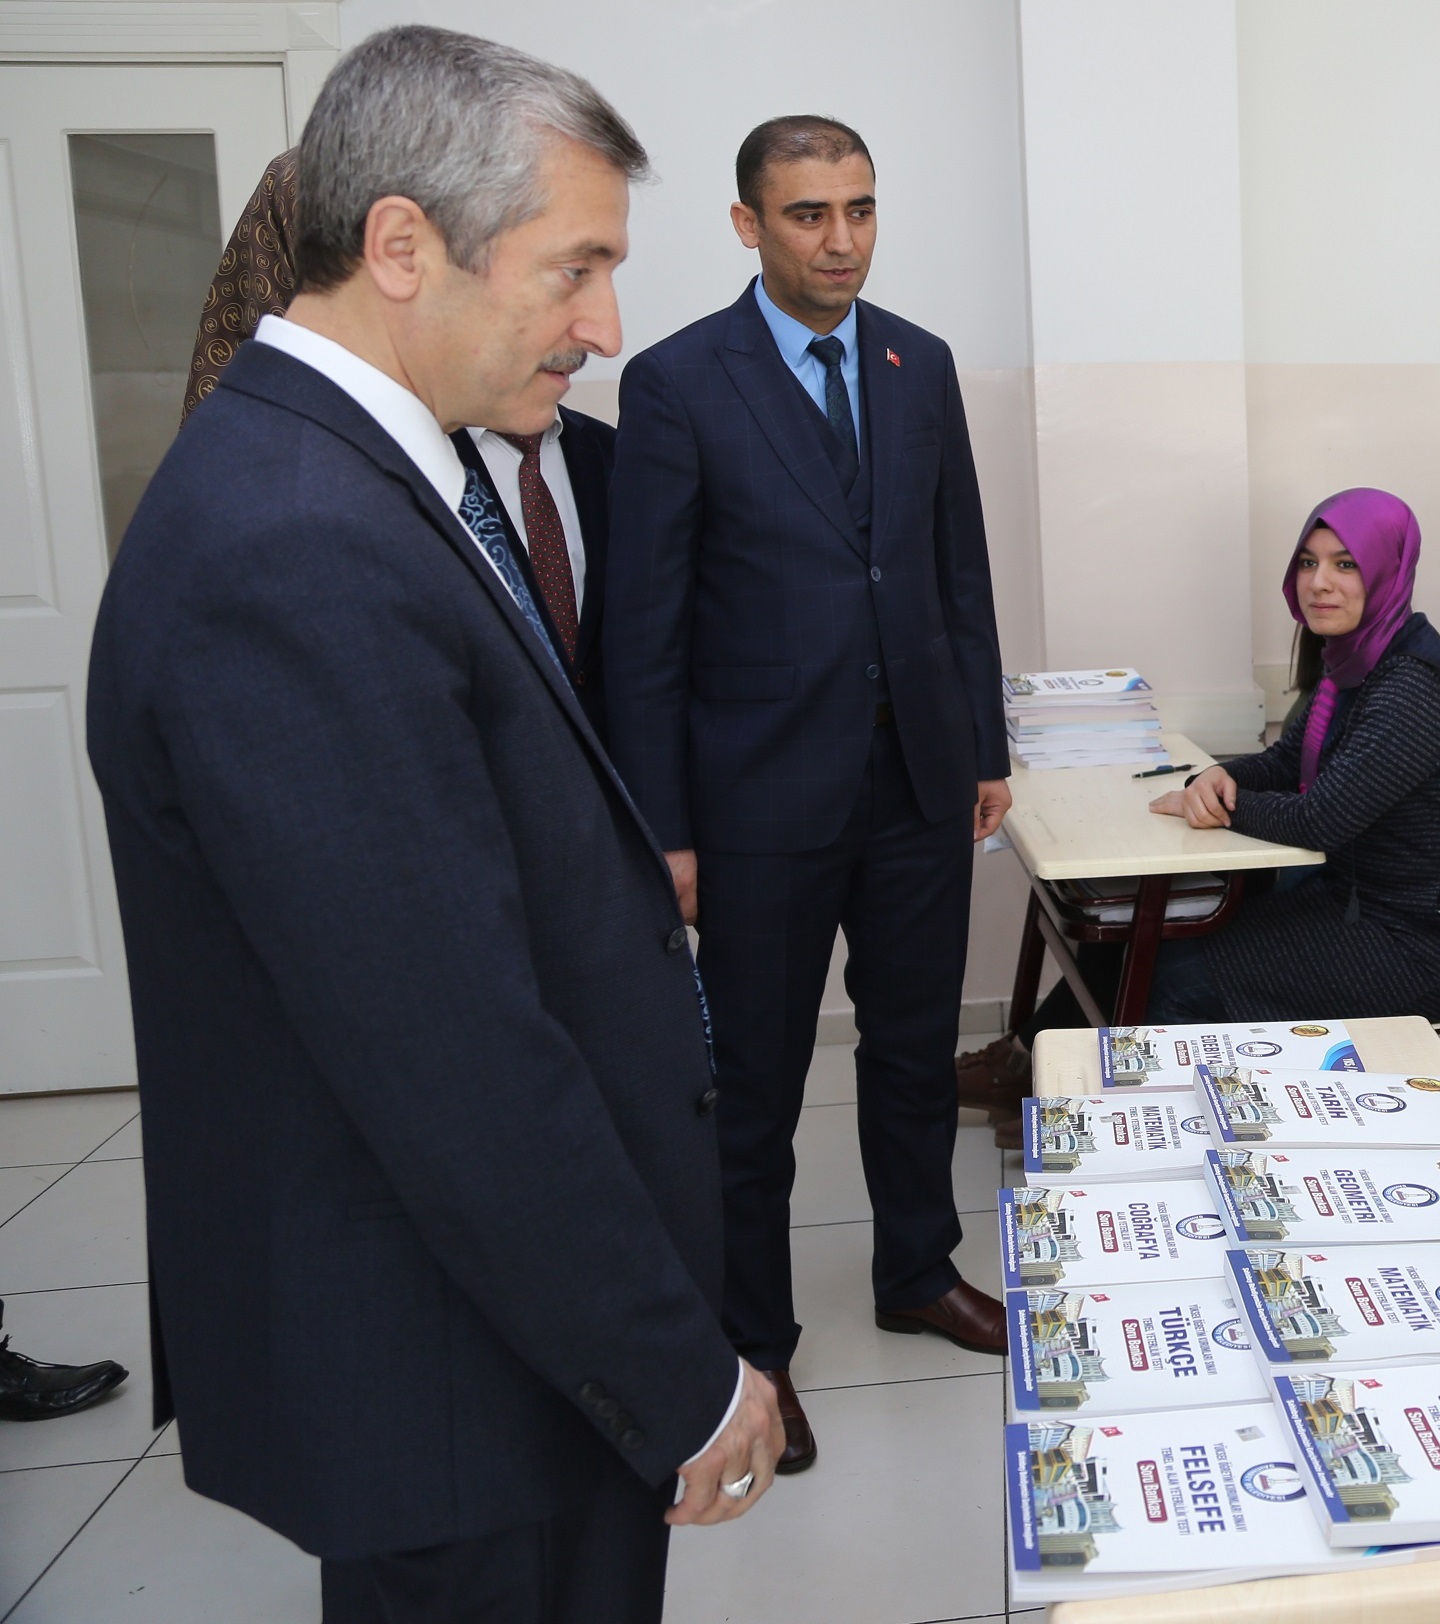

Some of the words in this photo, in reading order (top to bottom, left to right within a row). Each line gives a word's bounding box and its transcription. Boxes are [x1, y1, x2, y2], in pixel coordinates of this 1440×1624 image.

[1200, 1034, 1226, 1064] EDEBİYA
[1286, 1087, 1301, 1097] Soru
[1314, 1086, 1349, 1118] TARİH
[1291, 1097, 1311, 1115] Bankası
[1115, 1124, 1128, 1142] Bankası
[1141, 1105, 1171, 1150] MATEMATİK
[1305, 1179, 1321, 1191] Soru
[1311, 1192, 1331, 1213] Bankası
[1332, 1169, 1384, 1222] GEOMETRİ
[1098, 1213, 1112, 1226] Soru
[1101, 1226, 1117, 1249] Bankası
[1127, 1202, 1160, 1259] COĞRAFYA
[1347, 1280, 1367, 1296] Soru
[1376, 1266, 1436, 1331] MATEMATİK
[1356, 1296, 1381, 1322] Bankası
[1123, 1322, 1140, 1338] Soru
[1142, 1317, 1155, 1332] TEMEL
[1157, 1306, 1198, 1377] TÜRKÇE
[1127, 1339, 1146, 1367] Bankası
[1407, 1411, 1429, 1431] Soru
[1160, 1446, 1175, 1464] TEMEL
[1213, 1442, 1227, 1461] YÜKSEK
[1139, 1463, 1157, 1483] Soru
[1166, 1472, 1179, 1485] ALAN
[1179, 1445, 1226, 1533] FELSEFE
[1143, 1483, 1165, 1518] Bankası
